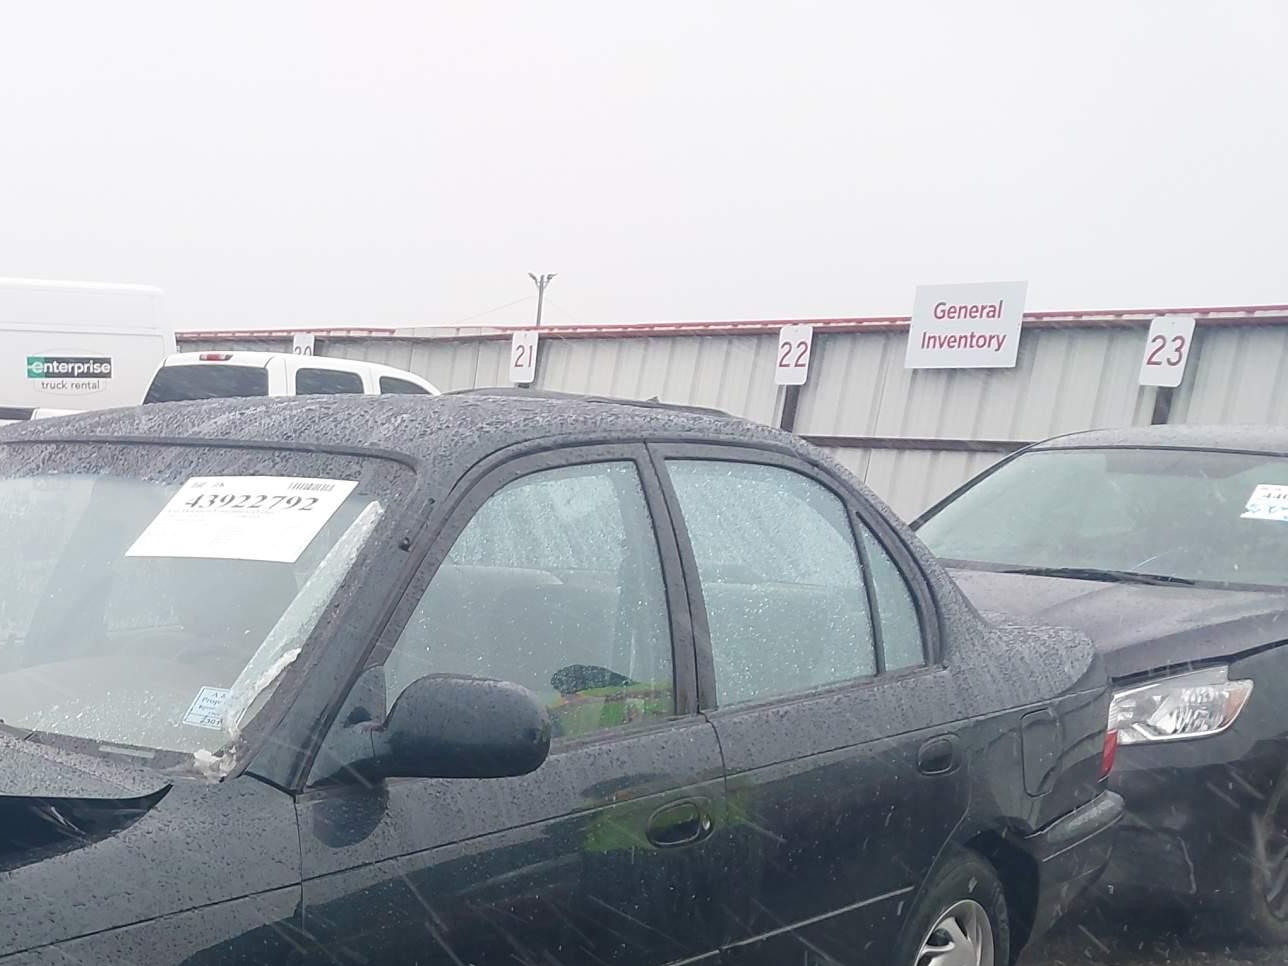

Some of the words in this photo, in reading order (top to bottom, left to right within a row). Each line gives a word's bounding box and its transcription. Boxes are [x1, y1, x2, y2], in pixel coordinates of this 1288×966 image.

[934, 300, 1003, 320] General
[921, 330, 1006, 352] Inventory
[1146, 334, 1186, 367] 23
[514, 344, 533, 368] 21
[778, 341, 809, 368] 22
[28, 360, 111, 376] enterprise
[41, 380, 68, 390] truck
[71, 379, 100, 390] rental
[185, 494, 319, 512] 43922792
